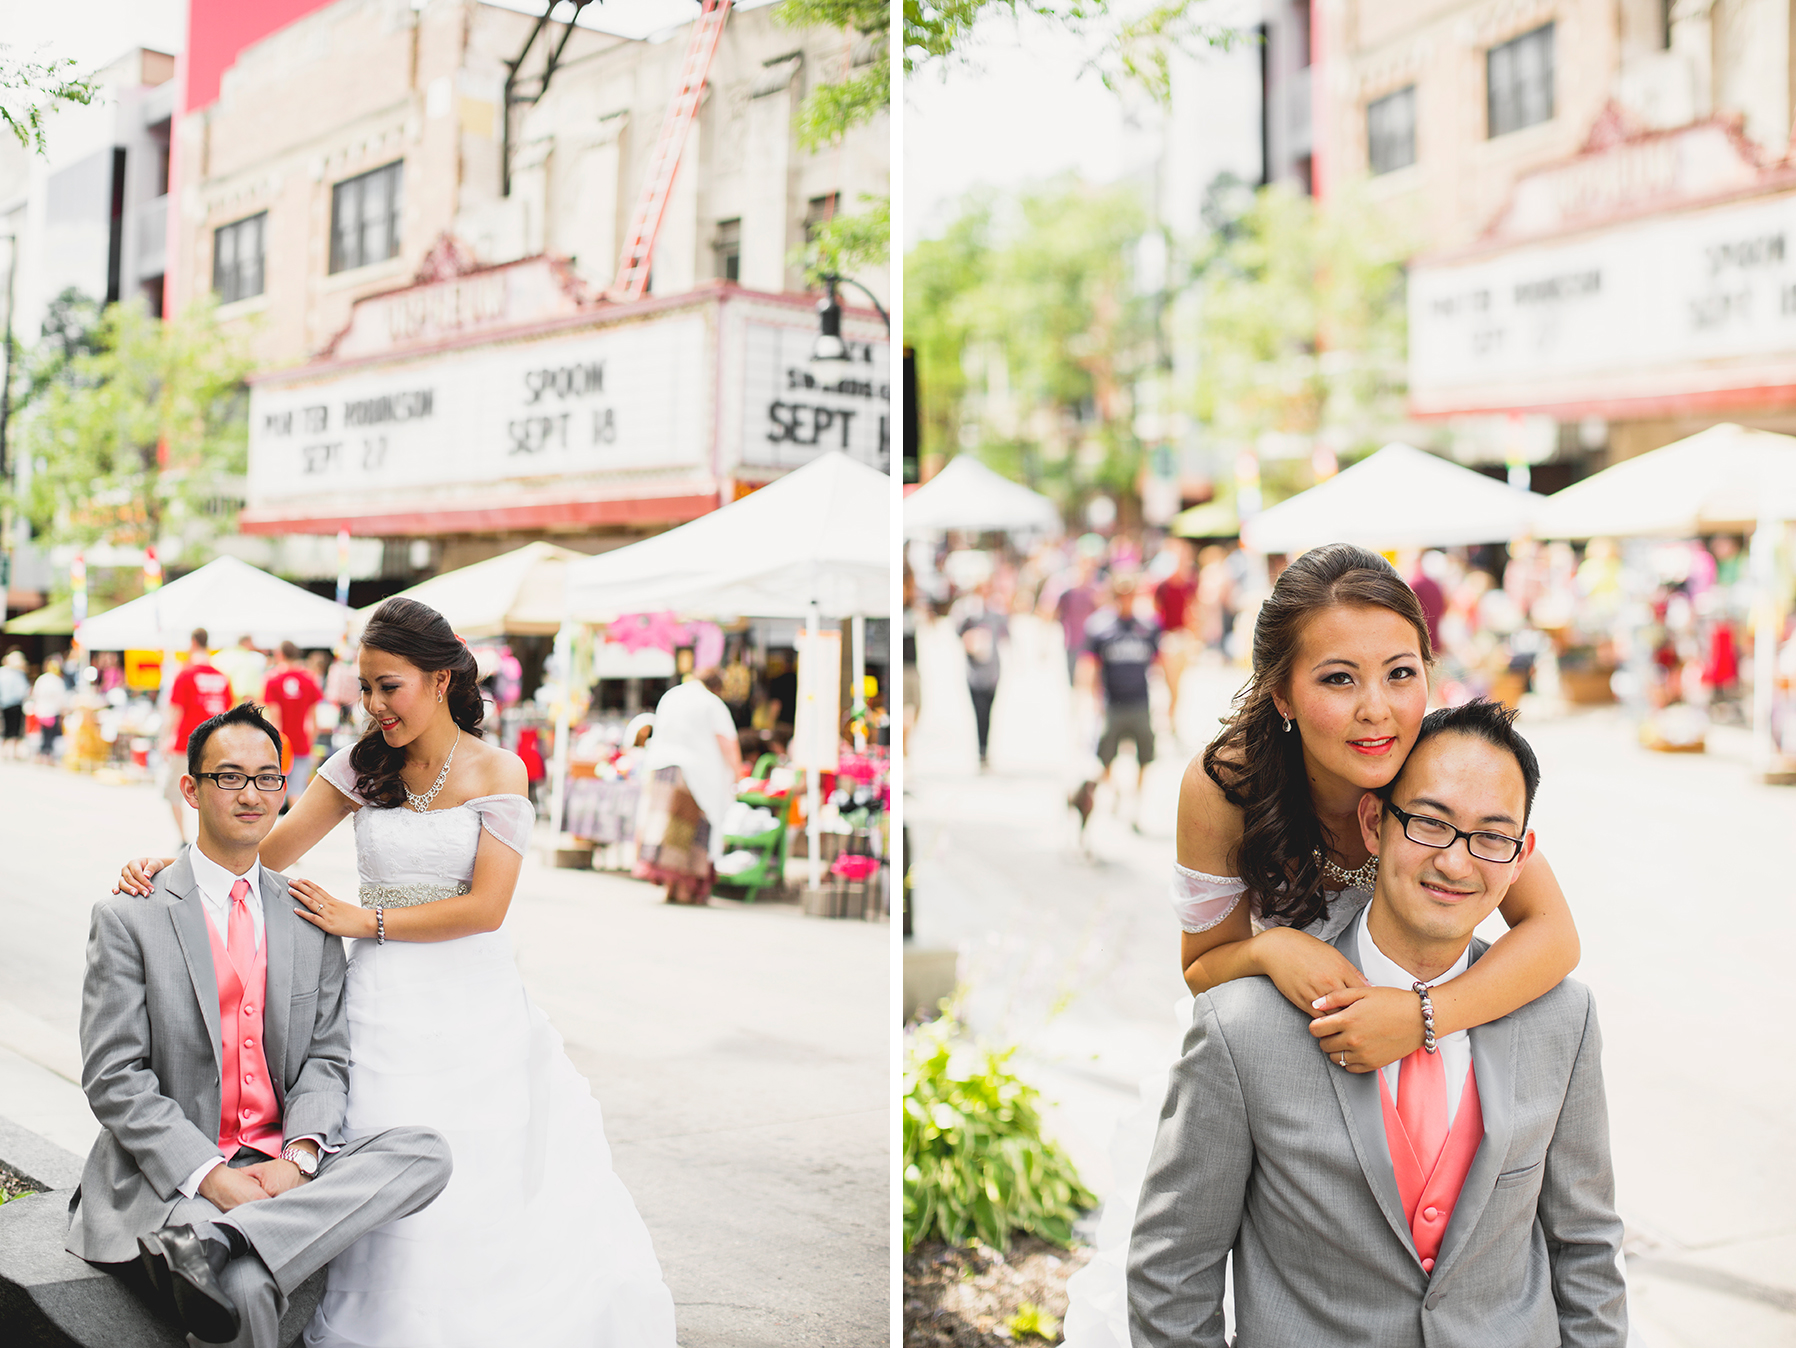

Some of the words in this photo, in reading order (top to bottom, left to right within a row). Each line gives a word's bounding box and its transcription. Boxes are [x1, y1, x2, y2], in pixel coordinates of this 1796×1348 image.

[524, 360, 606, 406] SPOON
[508, 413, 571, 456] SEPT
[593, 408, 616, 446] 18
[767, 401, 856, 448] SEPT
